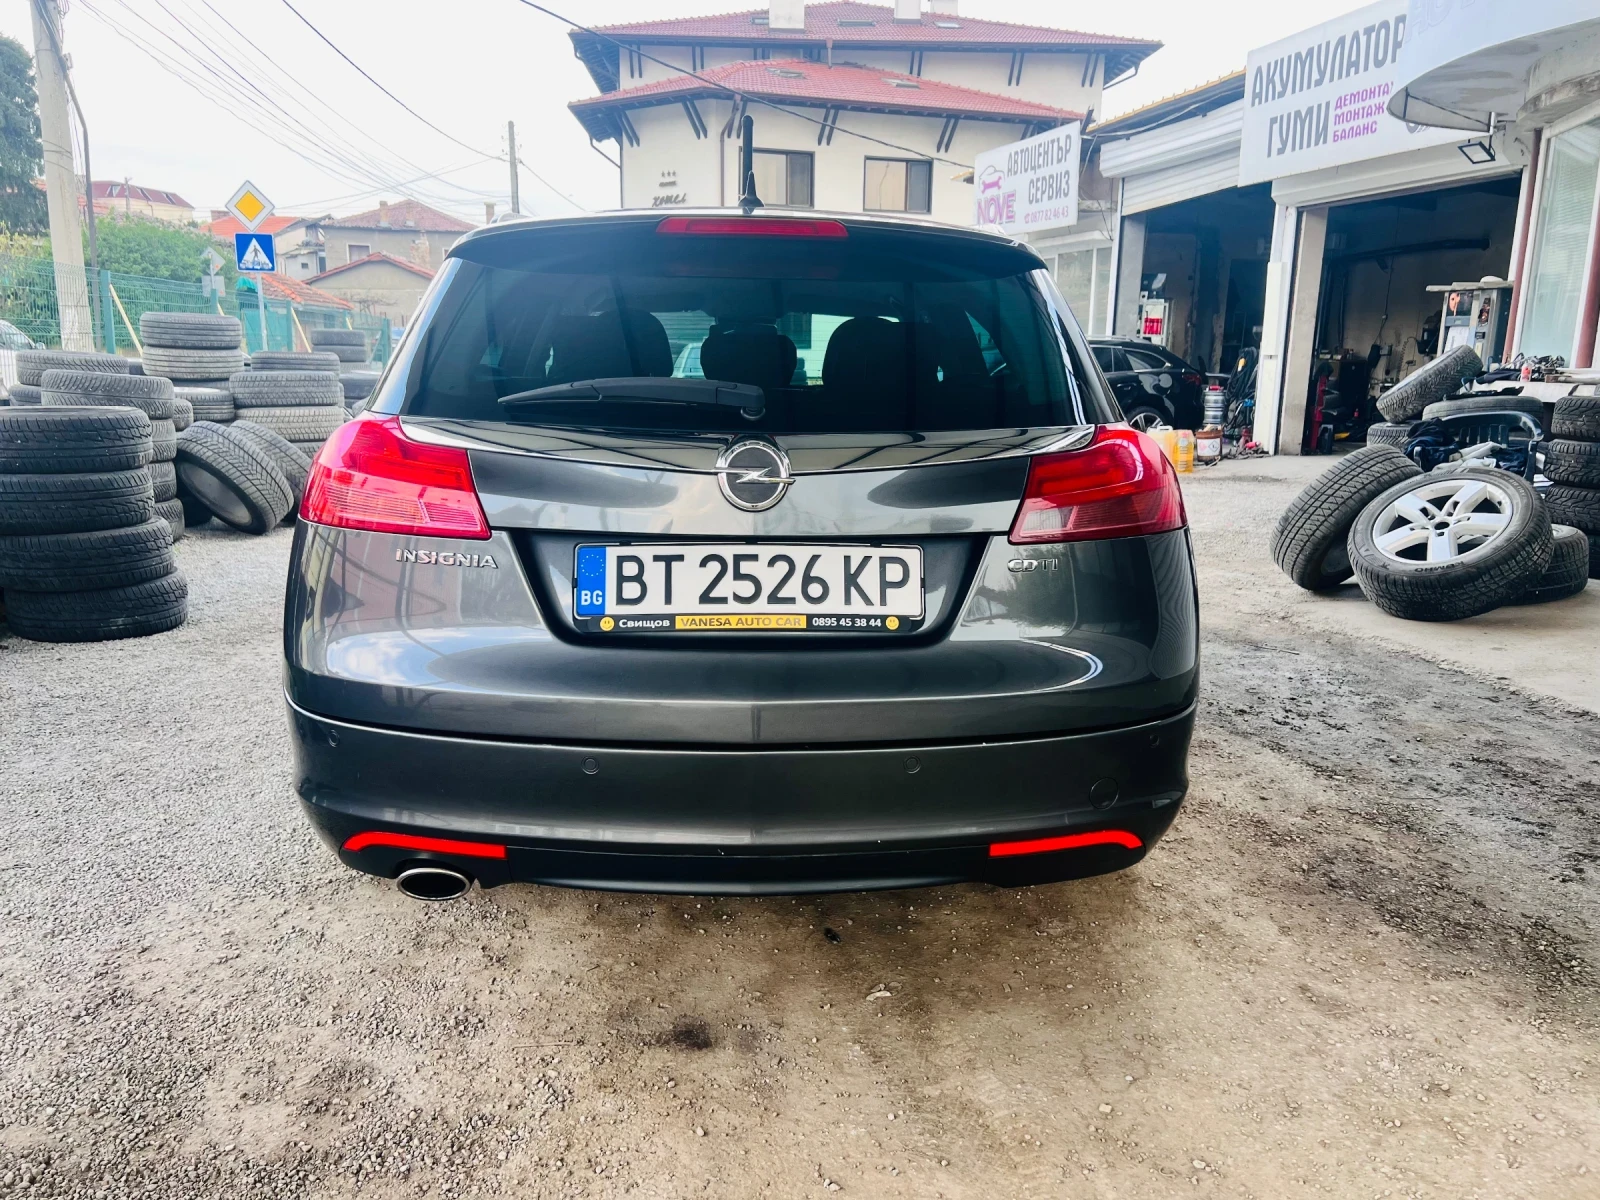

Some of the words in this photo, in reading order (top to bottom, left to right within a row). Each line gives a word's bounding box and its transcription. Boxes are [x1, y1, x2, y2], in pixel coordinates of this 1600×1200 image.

[1334, 81, 1394, 111] ДЕМОНТА
[1333, 101, 1385, 127] МОНТАЖ
[1267, 101, 1330, 158] ГУМИ
[1333, 120, 1378, 143] БАЛАНС
[1007, 134, 1072, 177] АВТОЦЕНТЪР
[1028, 170, 1070, 205] СЕРВИЗ
[976, 190, 1017, 226] NOVE
[396, 548, 498, 569] INSIGNIA
[615, 554, 685, 606] BT
[698, 553, 830, 605] 2526
[843, 555, 910, 606] KP
[580, 590, 603, 606] BG
[619, 619, 670, 629] Свищов
[681, 617, 732, 627] VANESA
[735, 617, 775, 627] AUTO
[775, 617, 802, 627] CAR
[812, 617, 837, 627] 0895
[839, 618, 852, 627] 45
[854, 618, 867, 627] 38
[869, 618, 882, 627] 44
